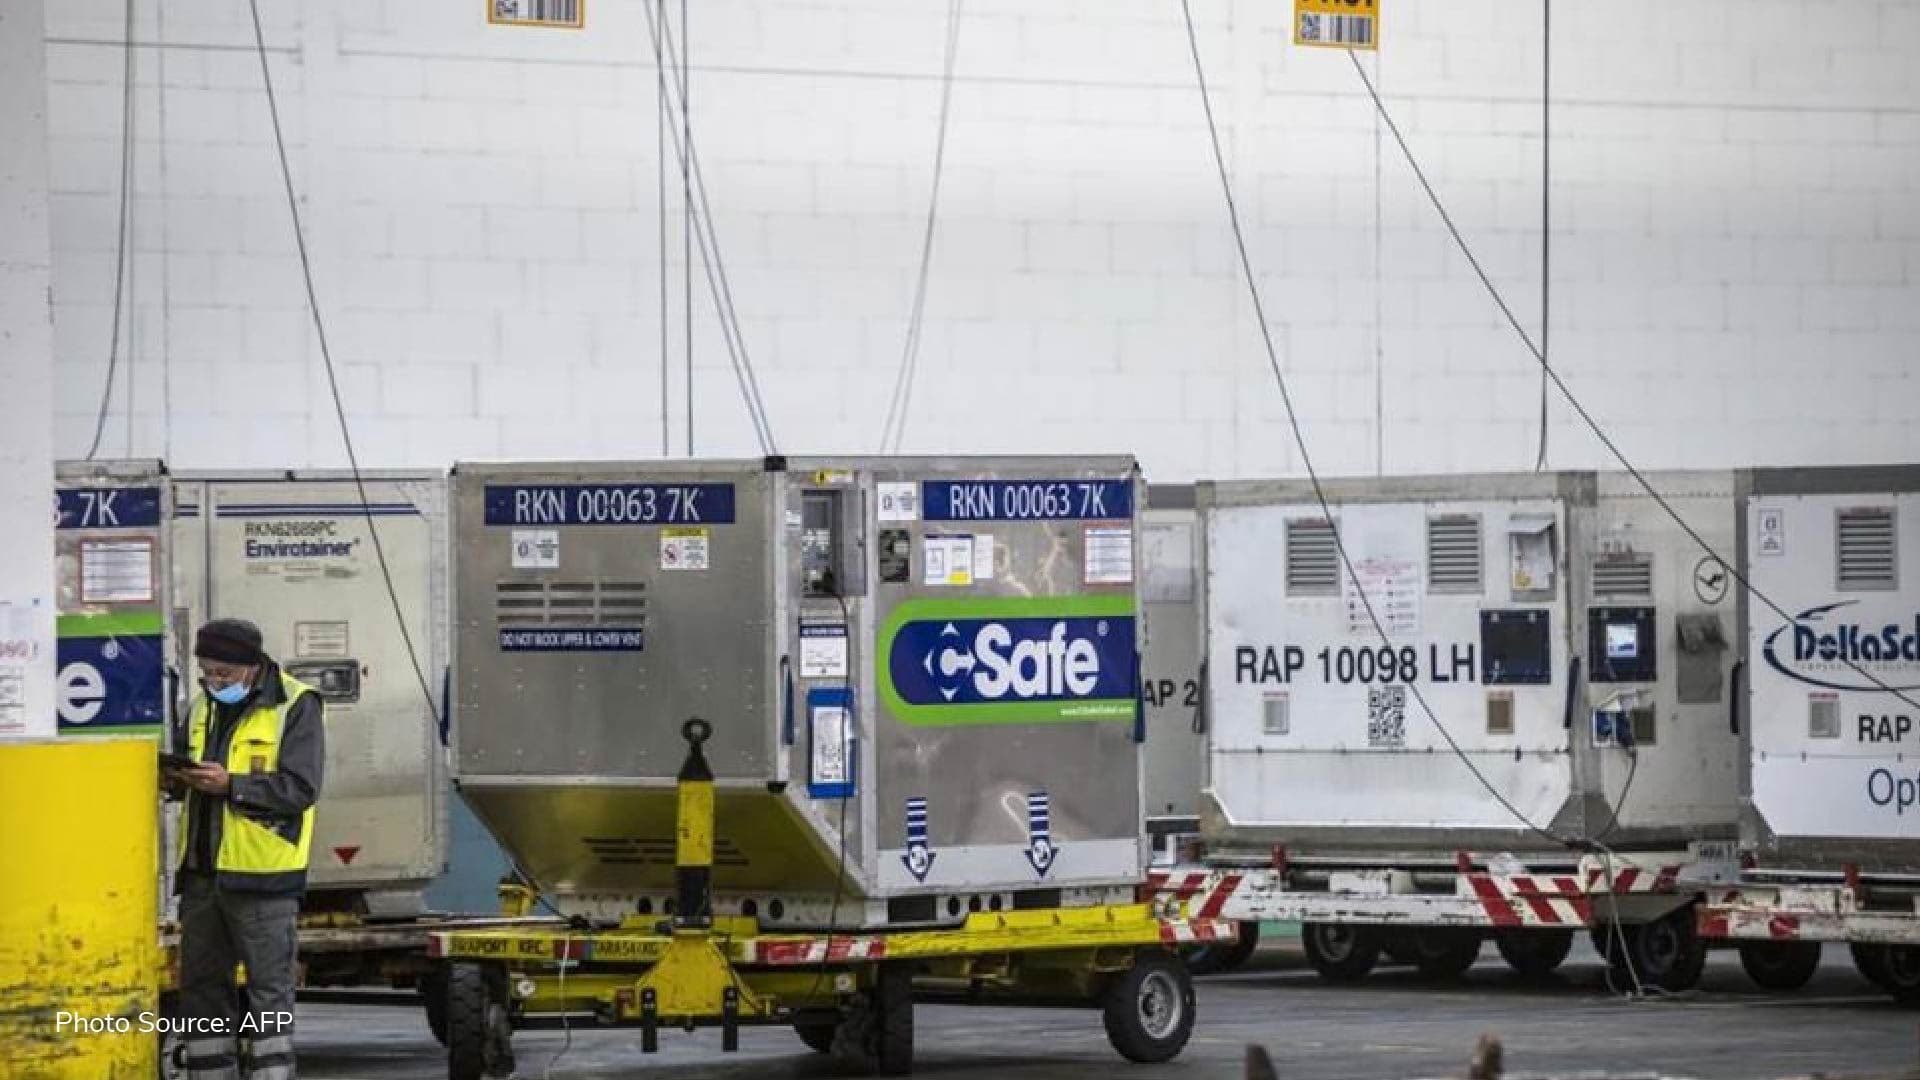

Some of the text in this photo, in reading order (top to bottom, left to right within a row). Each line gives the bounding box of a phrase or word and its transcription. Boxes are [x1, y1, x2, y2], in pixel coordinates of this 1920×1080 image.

[78, 491, 120, 525] 7K
[515, 487, 700, 523] RKN 00063 7K
[950, 485, 995, 519] RKN
[1004, 484, 1071, 518] 00063
[1079, 483, 1107, 517] 7K
[246, 538, 353, 557] Envirotainer
[1235, 643, 1475, 684] RAP 10098 LH
[1857, 714, 1911, 742] RAP
